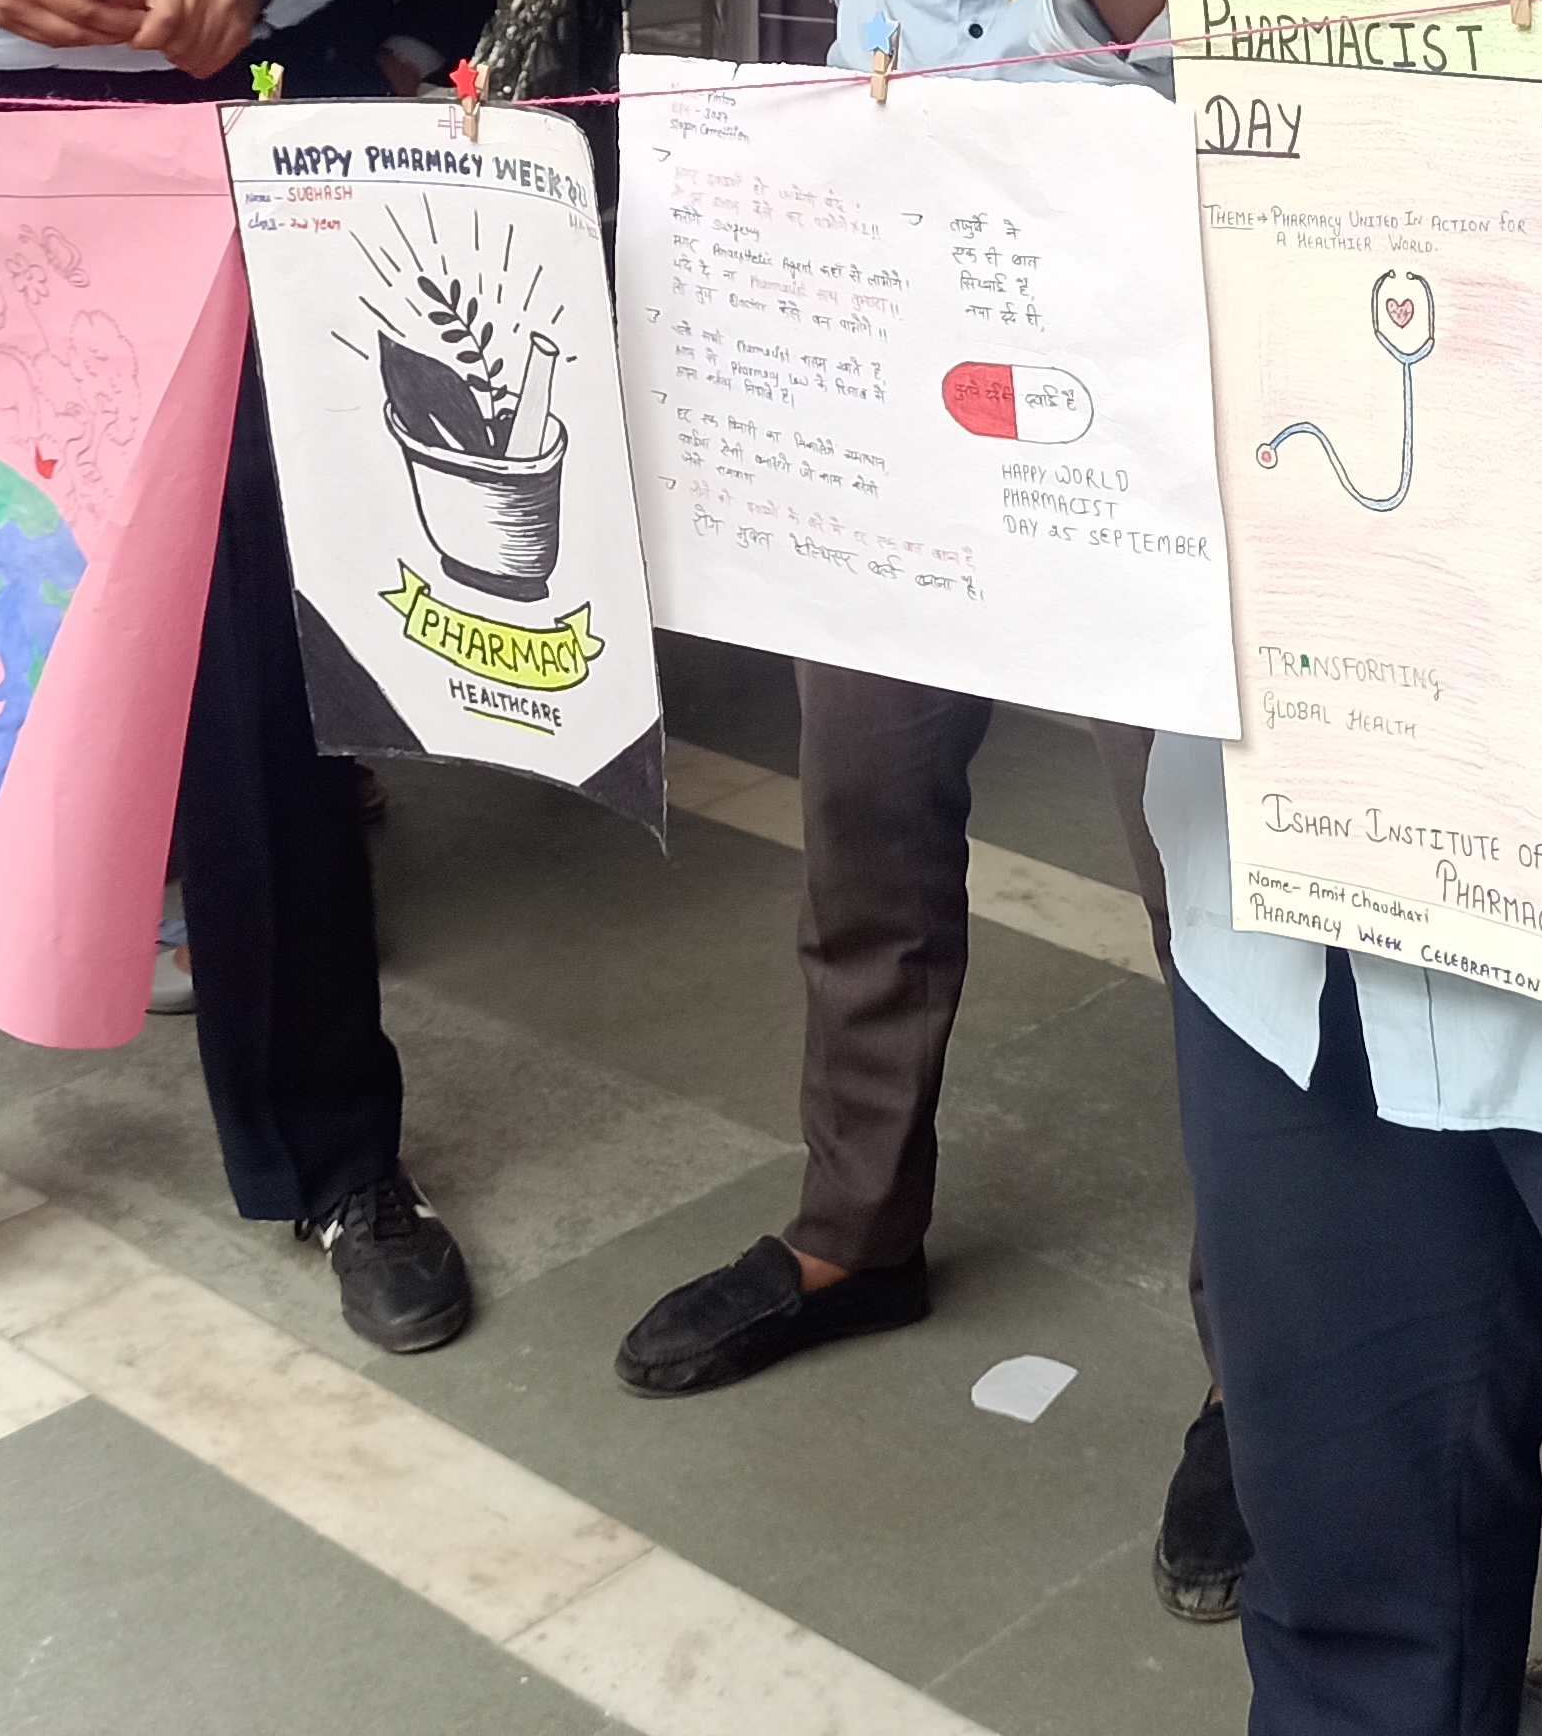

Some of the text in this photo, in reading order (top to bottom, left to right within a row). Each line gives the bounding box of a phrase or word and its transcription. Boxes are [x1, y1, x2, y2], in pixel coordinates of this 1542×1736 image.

[1204, 94, 1303, 154] DAY
[271, 144, 563, 200] HAPPY PHARMACY WEEK
[286, 184, 354, 204] SUBHASH
[1201, 203, 1255, 229] THEME
[1270, 204, 1341, 237] PHARMACY
[1348, 209, 1399, 229] UNITED
[1431, 214, 1491, 234] ACTION
[1276, 230, 1287, 246] A
[1297, 232, 1373, 251] HEALTHIER
[1000, 462, 1130, 494] HAPPY WORLD
[1002, 486, 1121, 521] PHARMACIST
[1002, 513, 1214, 563] DAY 25 SEPTEMBER
[420, 608, 582, 678] PHARMACY
[1258, 645, 1445, 702] TRANSFORMING
[447, 677, 564, 729] HEALTHCARE
[1263, 690, 1418, 740] GLOBAL HEALTH
[1260, 792, 1353, 839] ISHAN
[1364, 807, 1501, 863] INSTITUTE
[1308, 881, 1347, 903] Amit
[1249, 891, 1342, 942] PHARMACY
[1420, 943, 1542, 994] CELEBRATION
